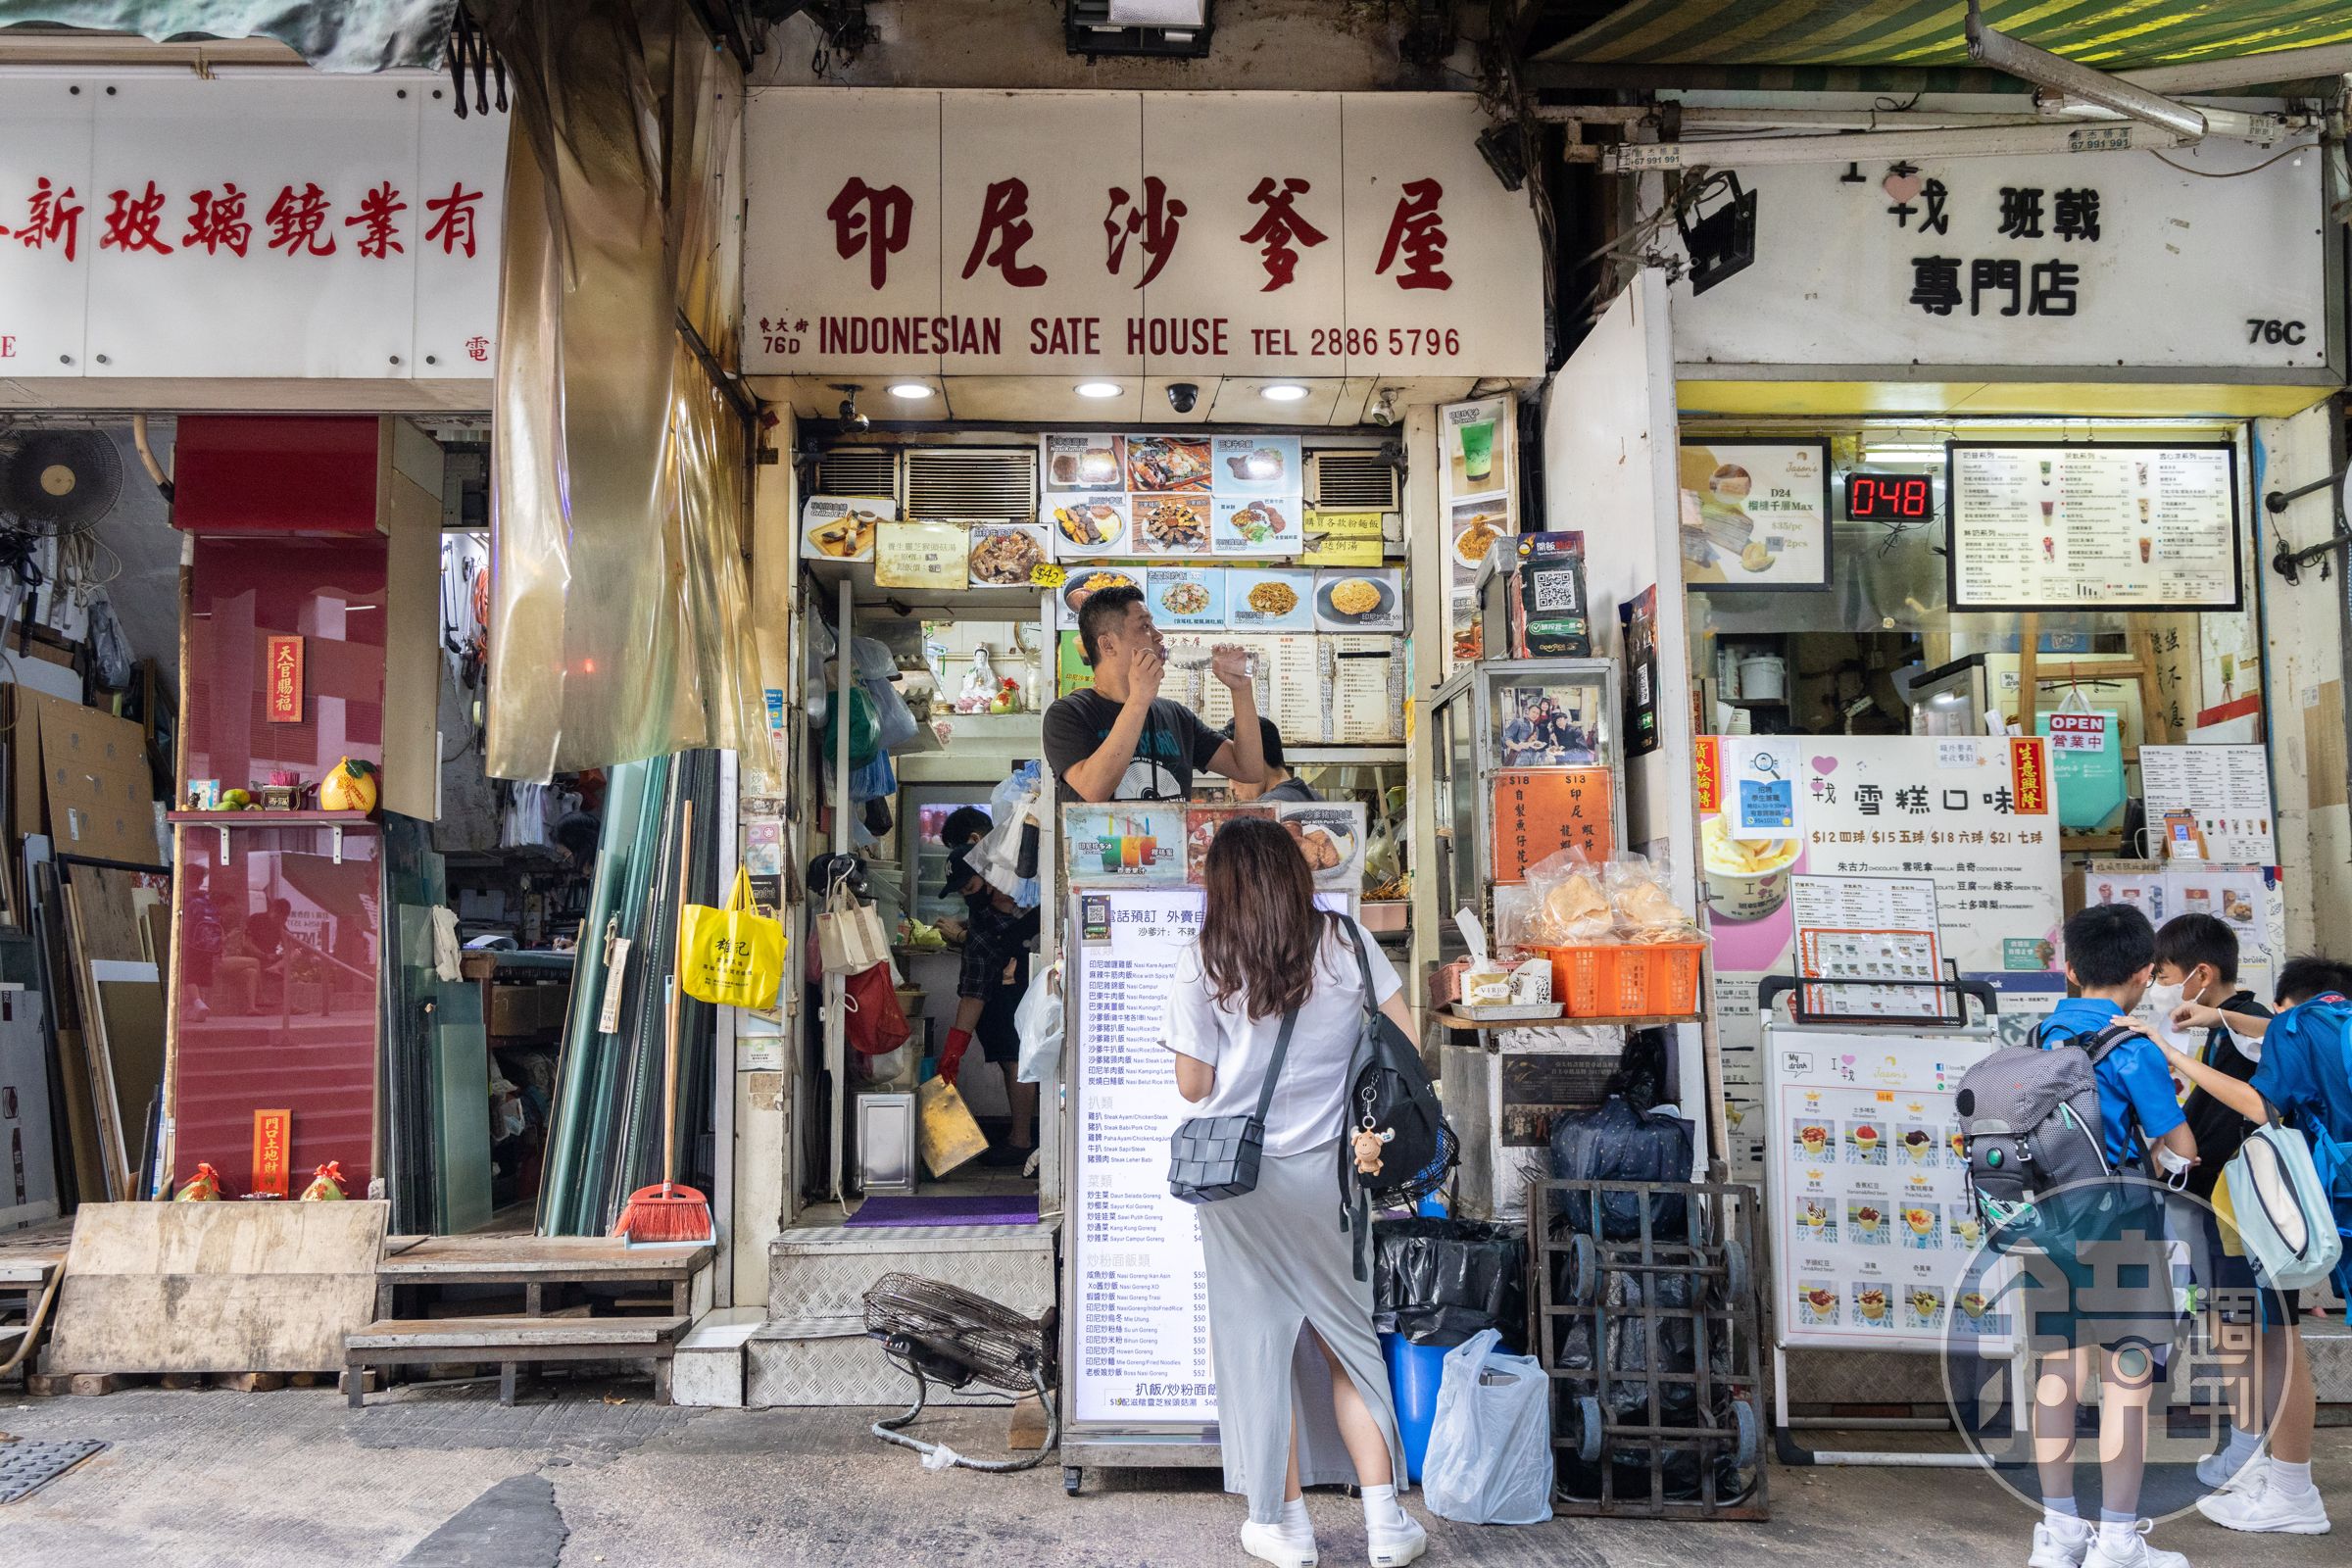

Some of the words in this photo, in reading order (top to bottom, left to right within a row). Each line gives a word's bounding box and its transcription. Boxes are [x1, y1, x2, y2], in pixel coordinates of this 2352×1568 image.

[2071, 141, 2083, 150] 67
[2087, 139, 2105, 149] 991
[2110, 138, 2129, 148] 991
[0, 177, 485, 262] 新玻璃鏡業有
[1998, 187, 2100, 242] 班戟
[826, 175, 1454, 292] 印尼沙爹屋
[1909, 257, 2080, 317] 專門店
[819, 315, 1001, 355] INDONESIAN
[1030, 317, 1101, 355] SATE
[1128, 317, 1229, 355] HOUSE
[1251, 328, 1298, 356] TEL
[1311, 327, 1379, 357] 2886
[1389, 327, 1460, 356] 5796
[2246, 319, 2305, 346] 76C
[763, 336, 801, 354] 76D
[1771, 488, 1791, 498] D24
[1853, 479, 1926, 515] 048
[1035, 567, 1059, 585] $42
[276, 646, 295, 711] 天官賜福
[2051, 717, 2103, 729] OPEN
[2053, 734, 2102, 749] 營業中
[1509, 775, 1530, 785] $18
[1565, 775, 1586, 784] $13
[2018, 744, 2041, 808] 生意興隆
[1570, 788, 1584, 818] 印尼
[1854, 784, 2015, 815] 雪糕口味
[1515, 789, 1528, 878] 自製魚仔花生
[1812, 831, 1836, 843] $12
[1872, 832, 1896, 843] $15
[1899, 831, 1925, 843] 五球
[1931, 832, 1955, 843] $18
[1959, 831, 1984, 843] 六球
[1990, 832, 2011, 843] $21
[2018, 831, 2043, 843] 七球
[1838, 862, 1868, 872] 朱古力
[1957, 881, 1977, 891] 豆腐
[1993, 881, 2013, 891] 綠茶
[1958, 900, 1999, 910] 士多啤梨
[264, 1117, 279, 1187] 門口土地財神
[1087, 1191, 1109, 1200] 炒生菜
